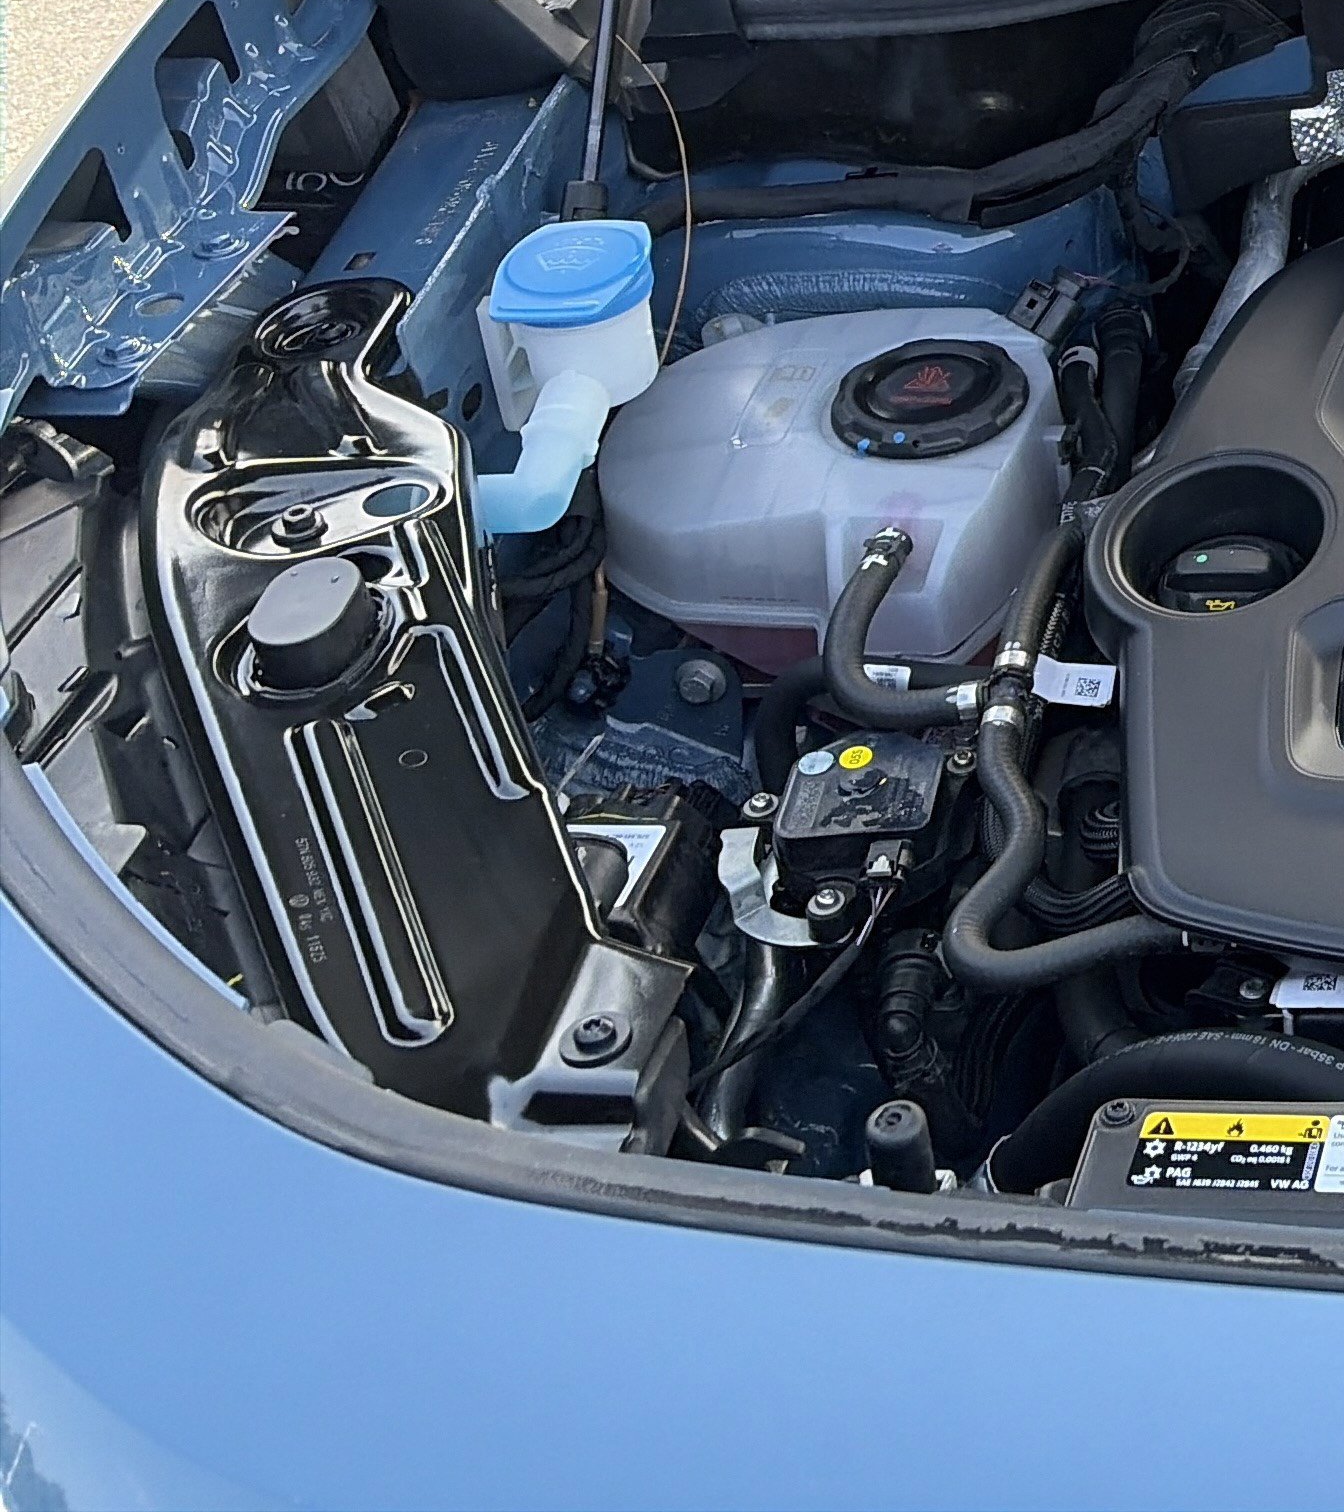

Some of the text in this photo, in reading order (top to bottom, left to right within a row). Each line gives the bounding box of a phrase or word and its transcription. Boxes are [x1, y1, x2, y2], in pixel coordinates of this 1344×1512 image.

[1174, 1141, 1294, 1156] R-1234yf 0.460 kg
[1170, 1153, 1192, 1162] GWP
[1165, 1167, 1193, 1179] PAG
[1175, 1179, 1192, 1187] SAE
[1270, 1179, 1290, 1189] VW
[1290, 1180, 1310, 1190] AG
